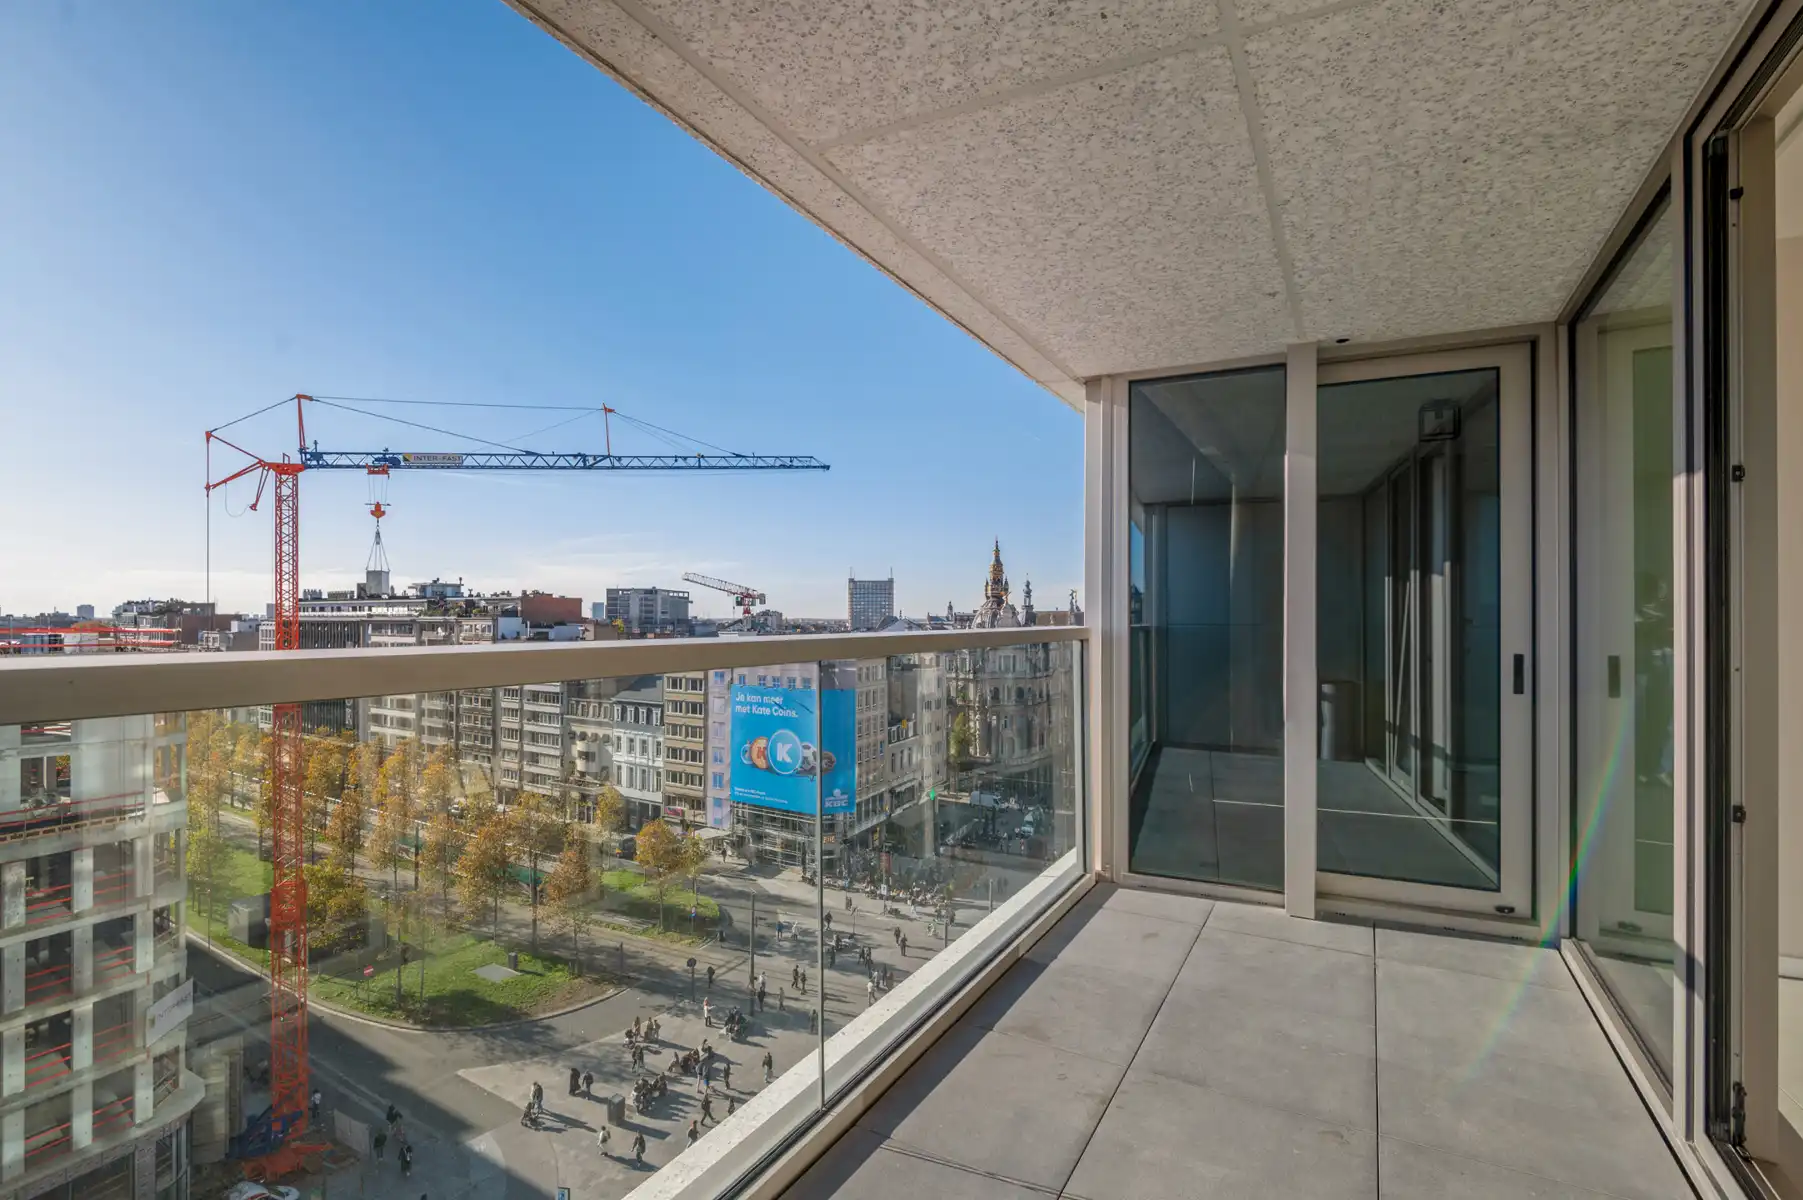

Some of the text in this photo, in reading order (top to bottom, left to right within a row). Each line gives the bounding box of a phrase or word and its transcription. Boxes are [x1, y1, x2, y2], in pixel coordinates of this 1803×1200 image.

[736, 692, 783, 705] Je kan meer
[735, 705, 750, 714] met
[752, 705, 770, 716] Kate
[776, 742, 793, 763] K
[824, 799, 848, 808] KBC
